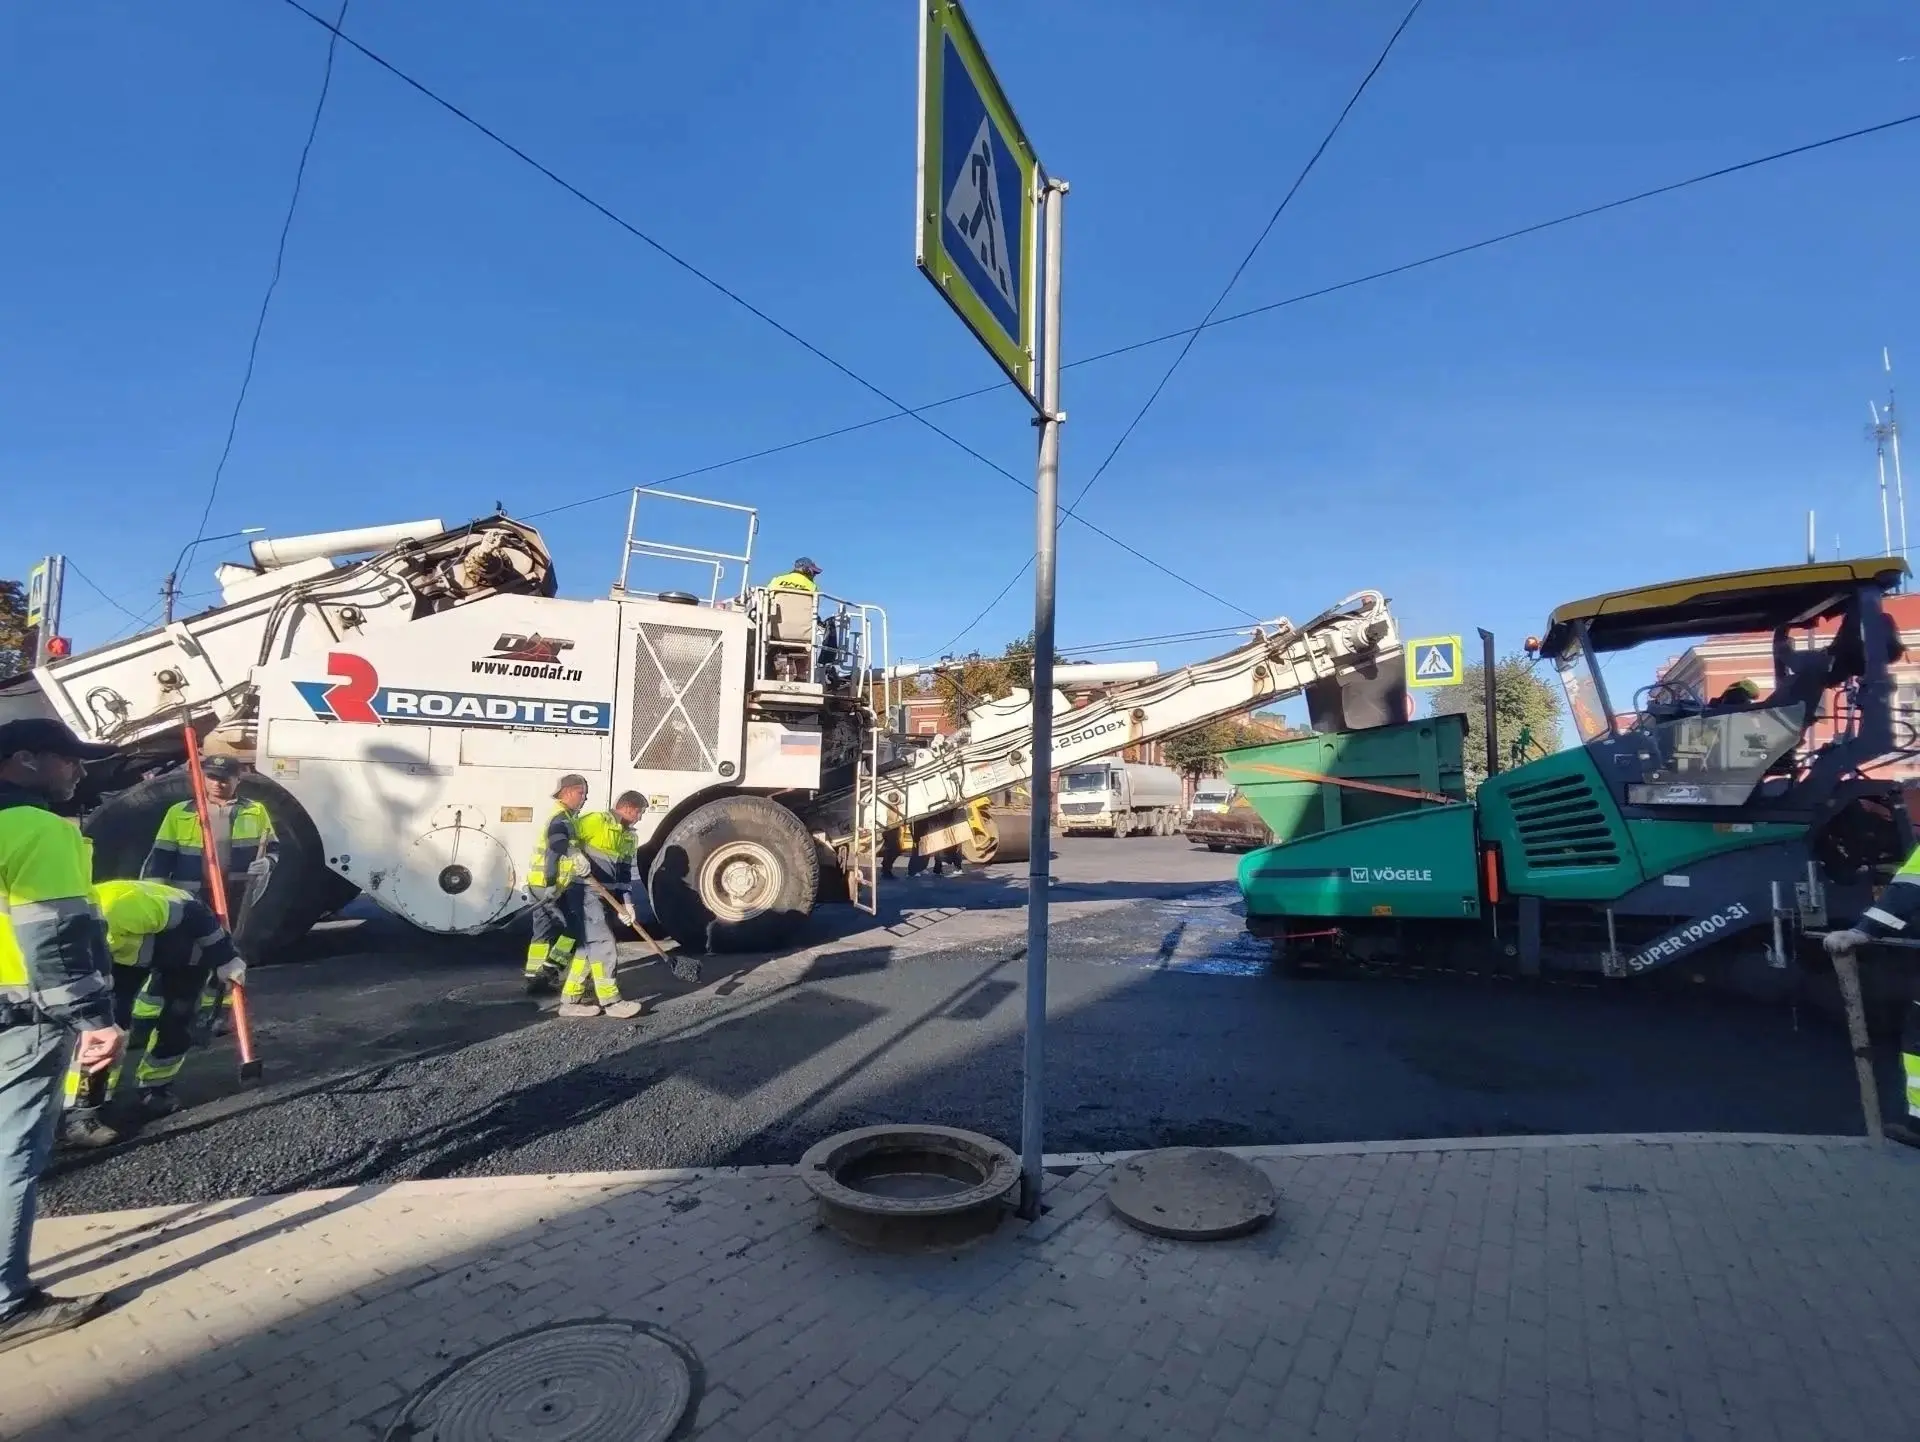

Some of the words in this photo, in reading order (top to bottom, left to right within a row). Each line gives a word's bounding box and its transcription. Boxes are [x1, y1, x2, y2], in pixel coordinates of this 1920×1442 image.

[471, 661, 582, 681] www.ooodaf.ru
[386, 692, 599, 725] ROADTEC
[1373, 867, 1432, 881] VÖGELE
[1628, 936, 1686, 971] SUPER
[1682, 902, 1750, 942] 1900-3i
